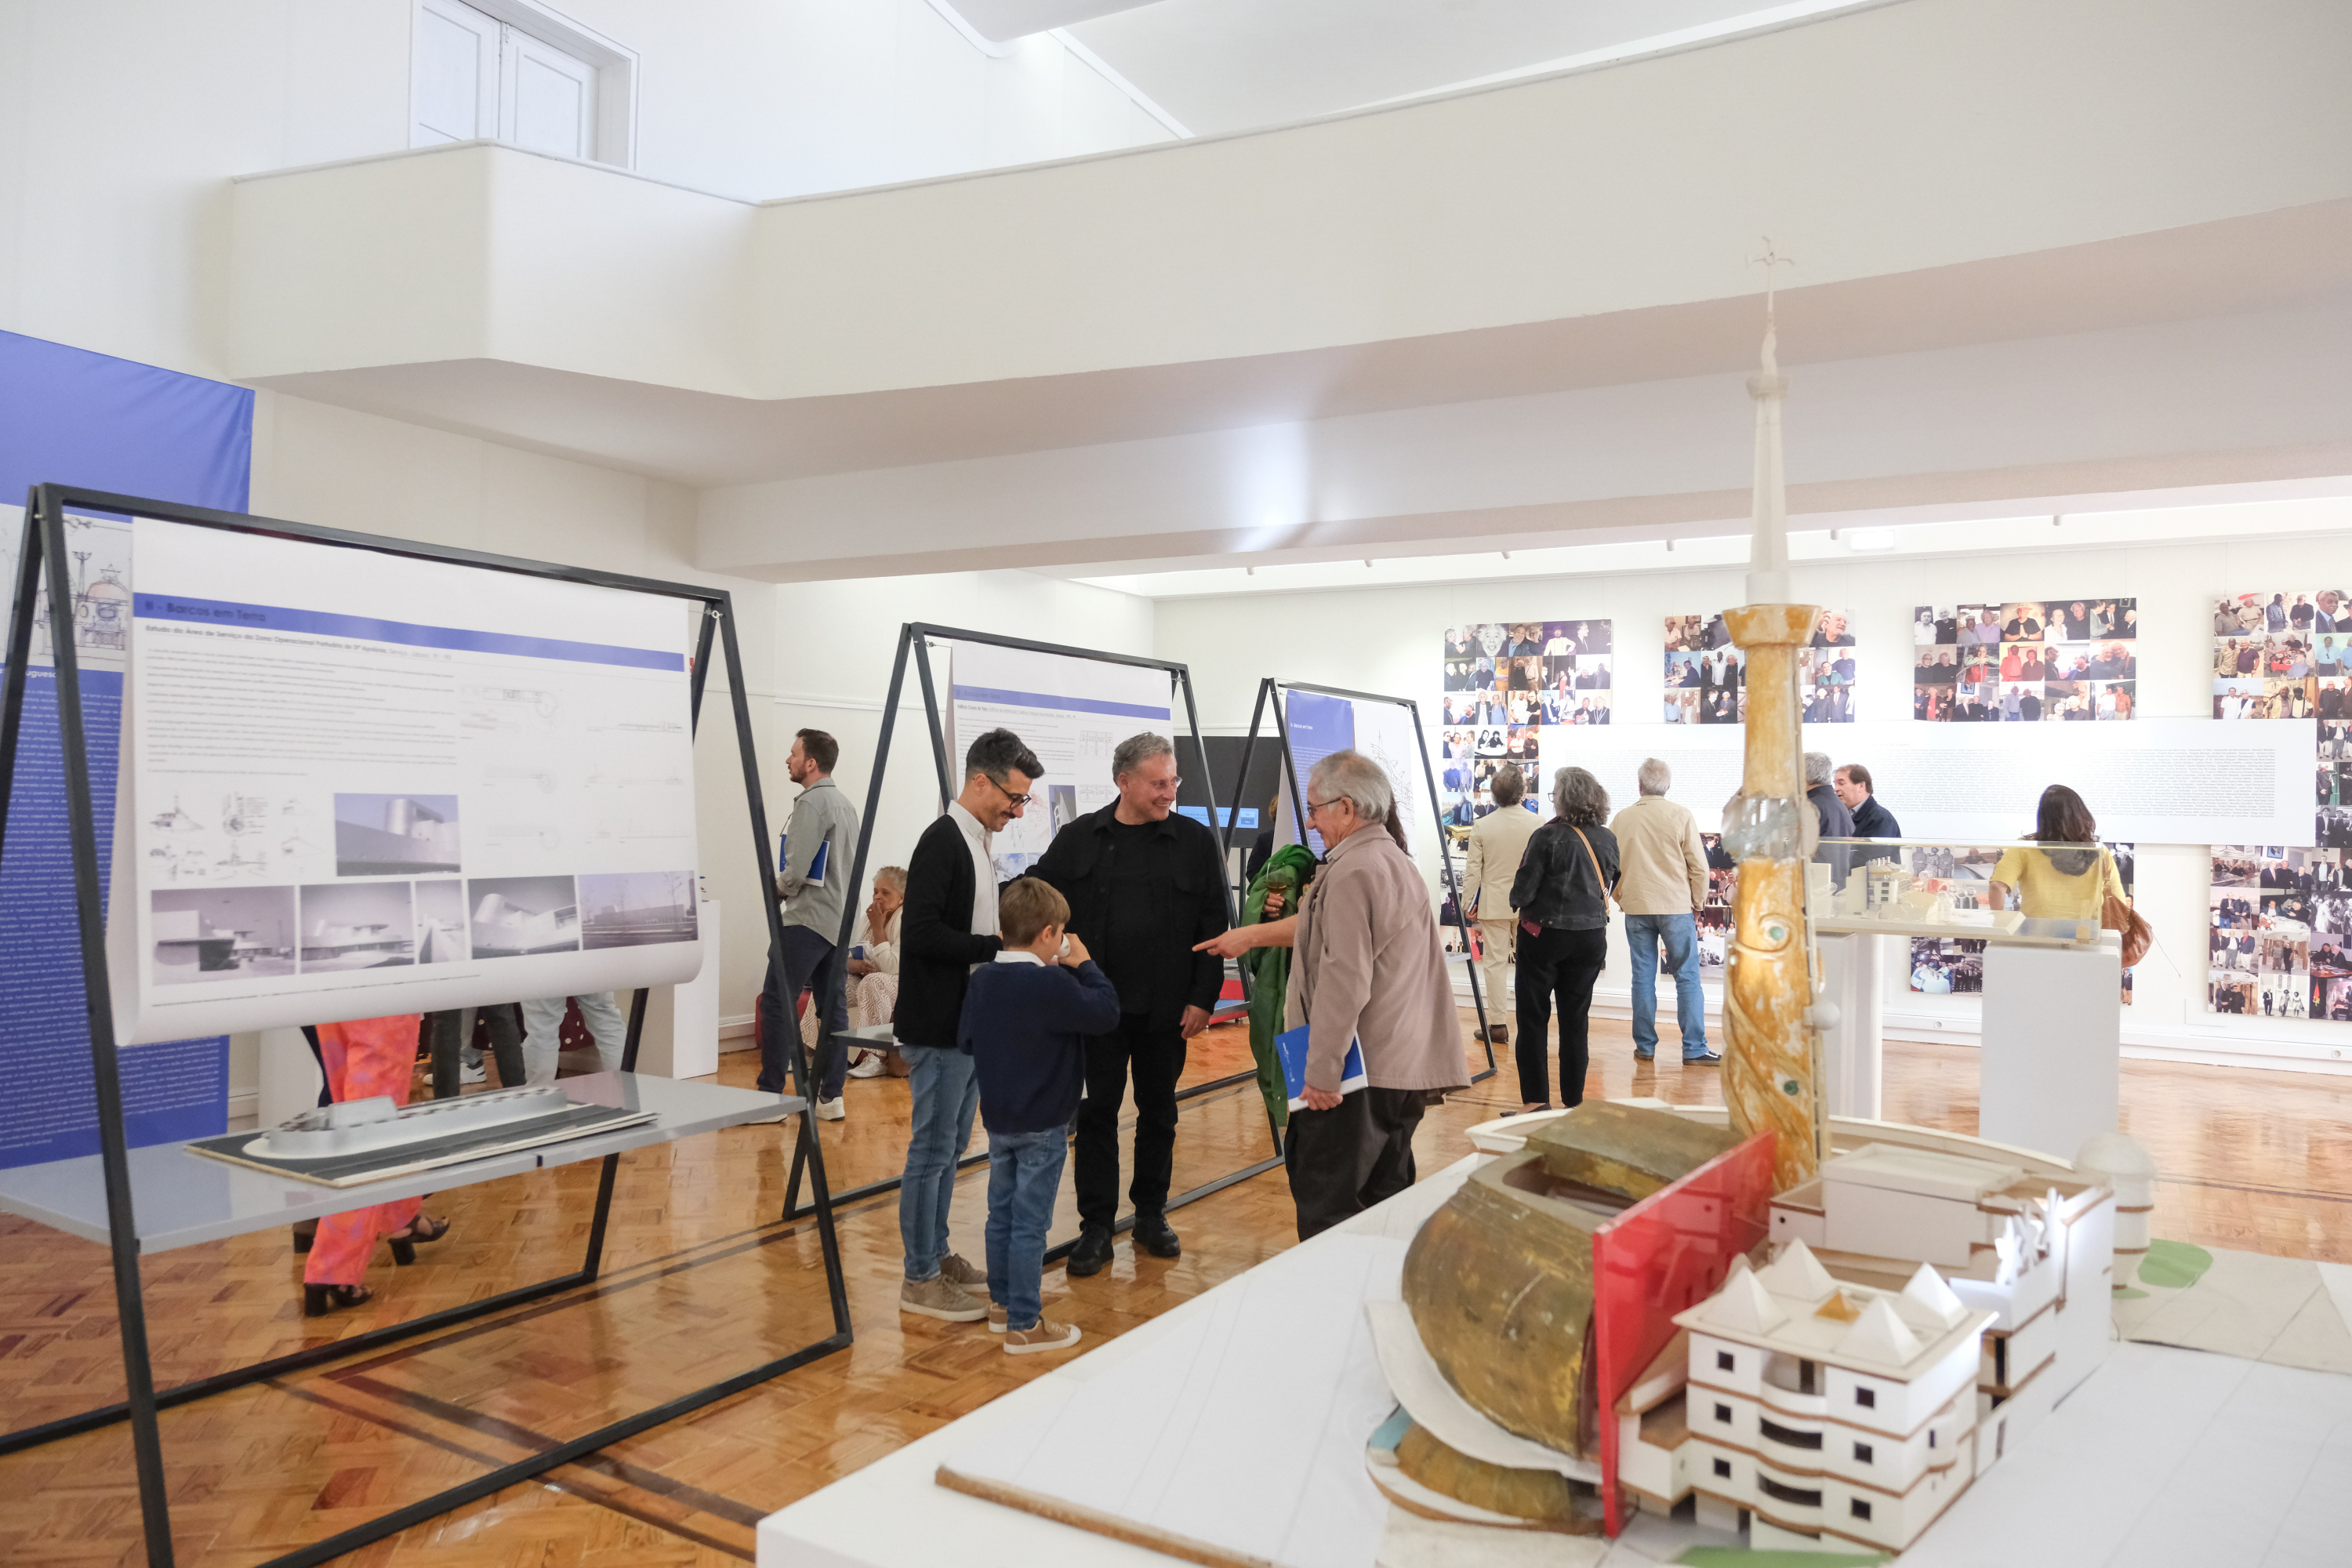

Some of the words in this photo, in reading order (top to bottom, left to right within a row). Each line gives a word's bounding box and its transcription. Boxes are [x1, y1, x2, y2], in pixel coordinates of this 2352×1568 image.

[167, 602, 211, 616] Barcos
[213, 609, 234, 618] em
[237, 609, 267, 622] Terra
[216, 630, 241, 640] Serviço
